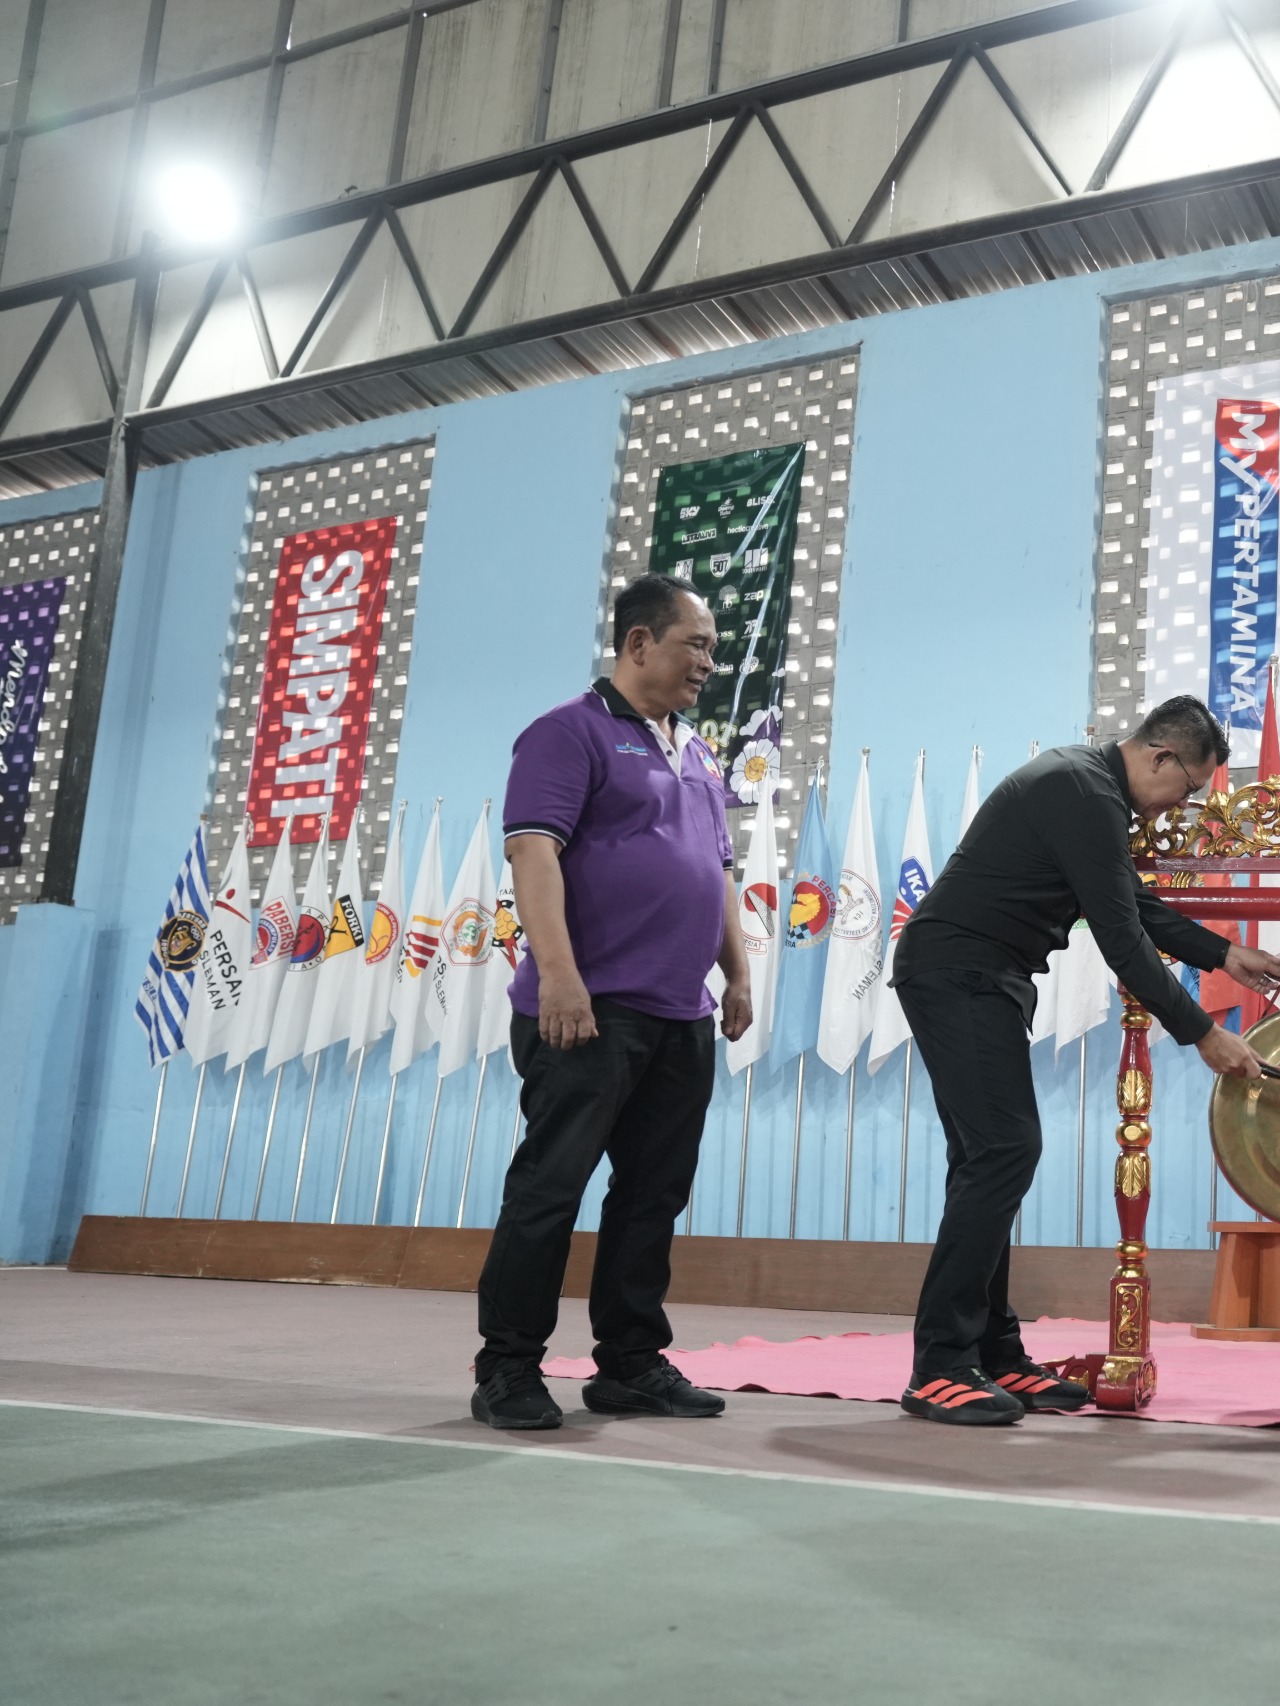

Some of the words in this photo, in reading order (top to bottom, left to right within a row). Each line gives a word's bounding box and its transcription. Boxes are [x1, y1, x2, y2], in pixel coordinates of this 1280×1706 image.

[270, 550, 364, 817] SIMPATI
[341, 901, 362, 941] FORKI
[199, 949, 226, 1011] SLEMAN
